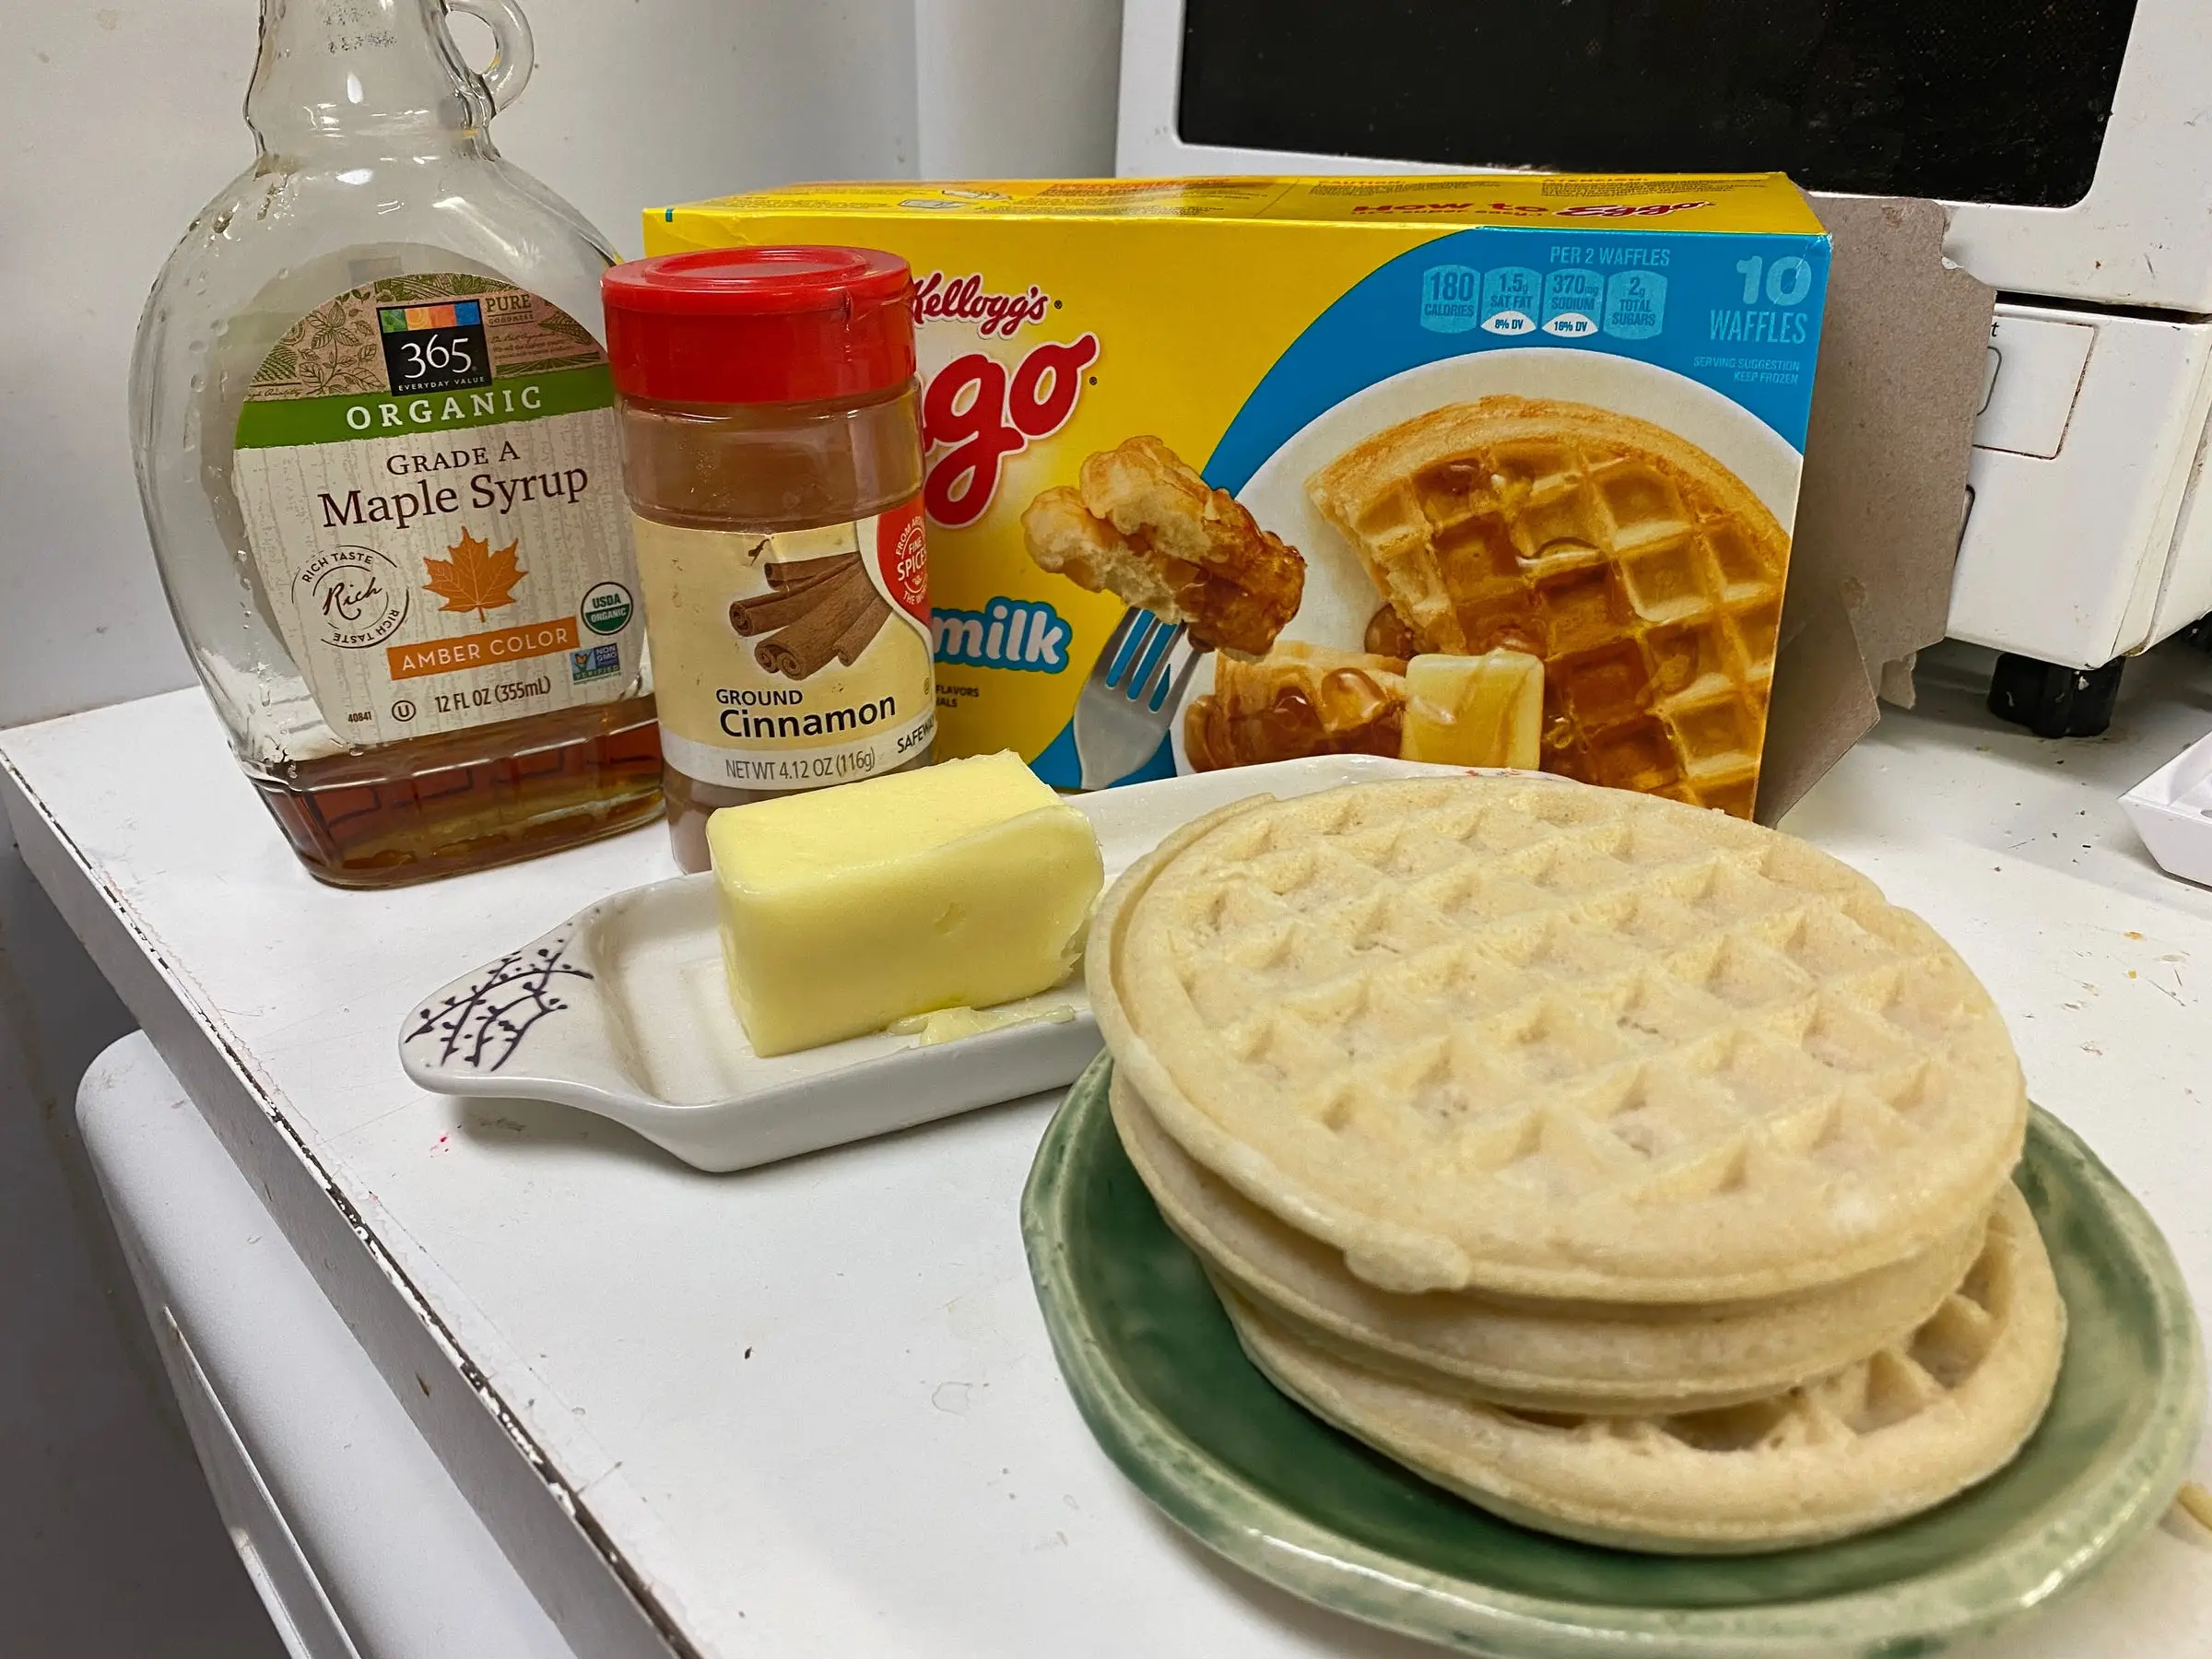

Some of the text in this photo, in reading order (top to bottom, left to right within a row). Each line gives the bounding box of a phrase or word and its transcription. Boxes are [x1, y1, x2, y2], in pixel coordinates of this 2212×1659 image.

[1352, 201, 1707, 218] How to Eggo
[1550, 246, 1670, 266] PER 2 WAFFLES
[1430, 272, 1474, 301] 180
[1736, 255, 1812, 306] 10
[485, 294, 532, 312] PURE
[913, 273, 1048, 336] Kellogg's
[1424, 303, 1475, 317] CALORIES
[1490, 296, 1533, 310] SAT FAT
[1551, 297, 1595, 311] SODIUM
[1619, 300, 1652, 312] TOTAL
[1512, 319, 1524, 330] DV
[1575, 321, 1588, 332] DV
[1612, 312, 1657, 326] SUGARS
[1710, 310, 1808, 345] WAFFLES
[401, 334, 472, 379] 365
[1693, 357, 1800, 371] SERVING SUGGESTION
[398, 376, 485, 392] EVERYDAY VALUE
[1734, 371, 1799, 384] KEEP FROZEN
[346, 385, 542, 430] ORGANIC
[924, 333, 1099, 526] go
[386, 441, 521, 476] GRADE A
[317, 467, 588, 530] Maple Syrup
[896, 523, 912, 556] FROM
[909, 536, 923, 555] FINE
[301, 552, 373, 582] RICH TASTE
[323, 577, 382, 620] Rich
[592, 594, 622, 608] USDA
[903, 590, 915, 605] THE
[591, 607, 627, 623] ORGANIC
[333, 609, 400, 644] RICH TASTE
[932, 605, 1063, 665] milk
[402, 628, 568, 671] AMBER COLOR
[596, 644, 616, 655] NON
[596, 652, 618, 662] GMO
[434, 676, 551, 713] 12 FL OZ (355mL)
[716, 688, 803, 706] GROUND
[935, 685, 980, 698] FLAVORS
[347, 711, 371, 724] 40841
[720, 696, 896, 738] Cinnamon
[897, 714, 935, 753] SAFEWA
[725, 747, 876, 780] NET WT 4.12 OZ (116g)
